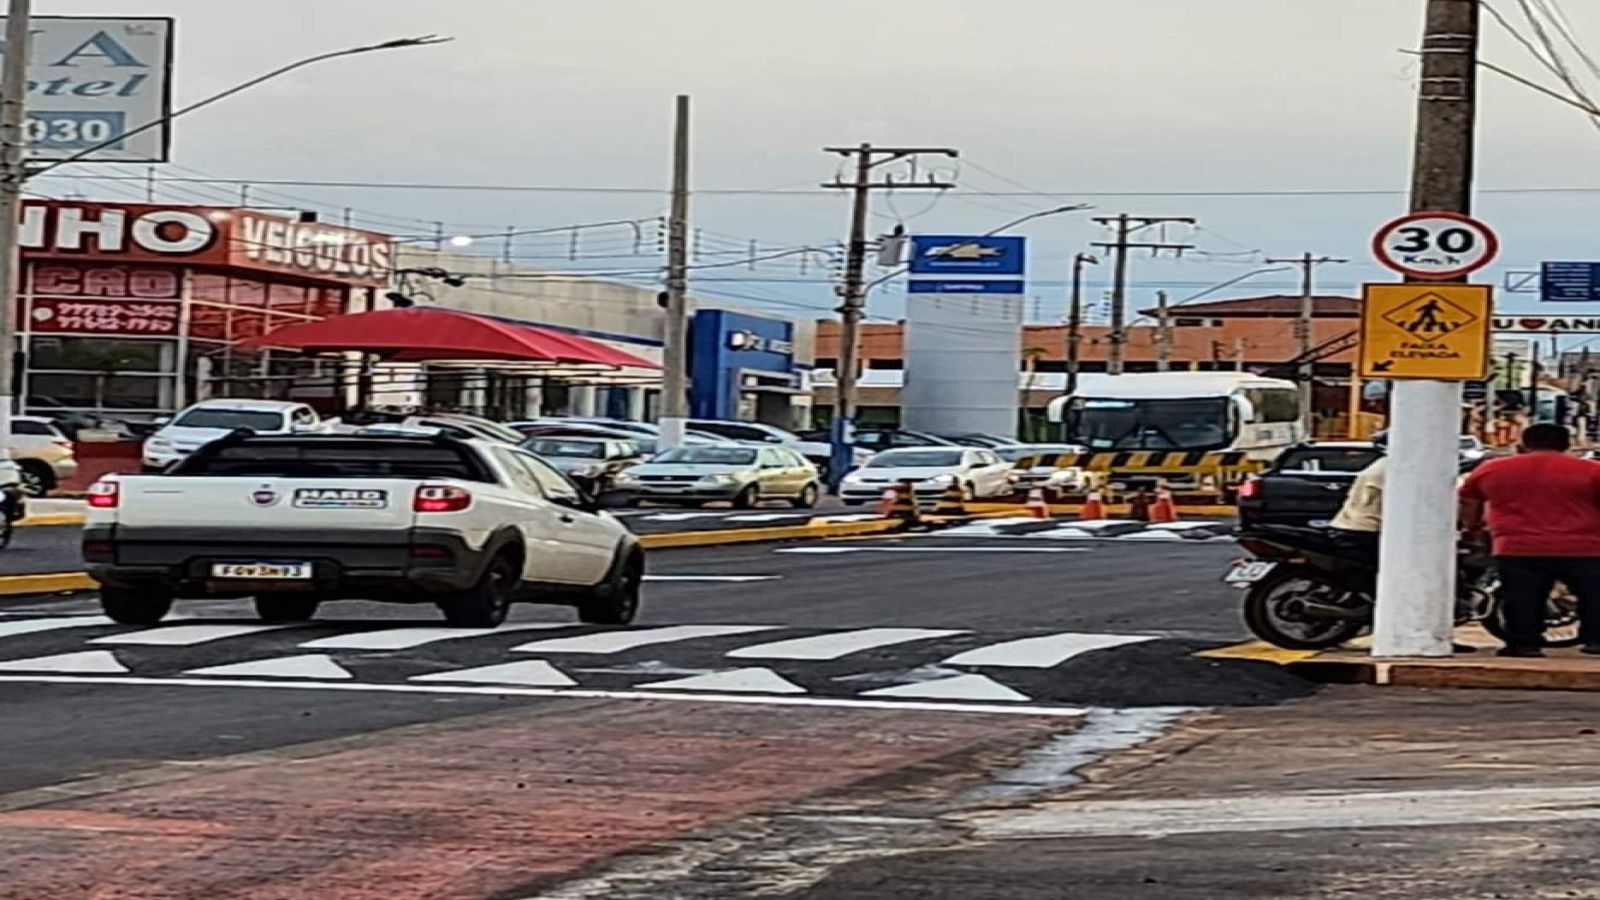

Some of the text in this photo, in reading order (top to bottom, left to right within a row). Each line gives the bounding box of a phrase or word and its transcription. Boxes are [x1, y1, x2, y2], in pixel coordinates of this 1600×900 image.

[1392, 227, 1475, 253] 30
[1390, 350, 1461, 359] ELEVADA
[299, 490, 381, 500] HARD
